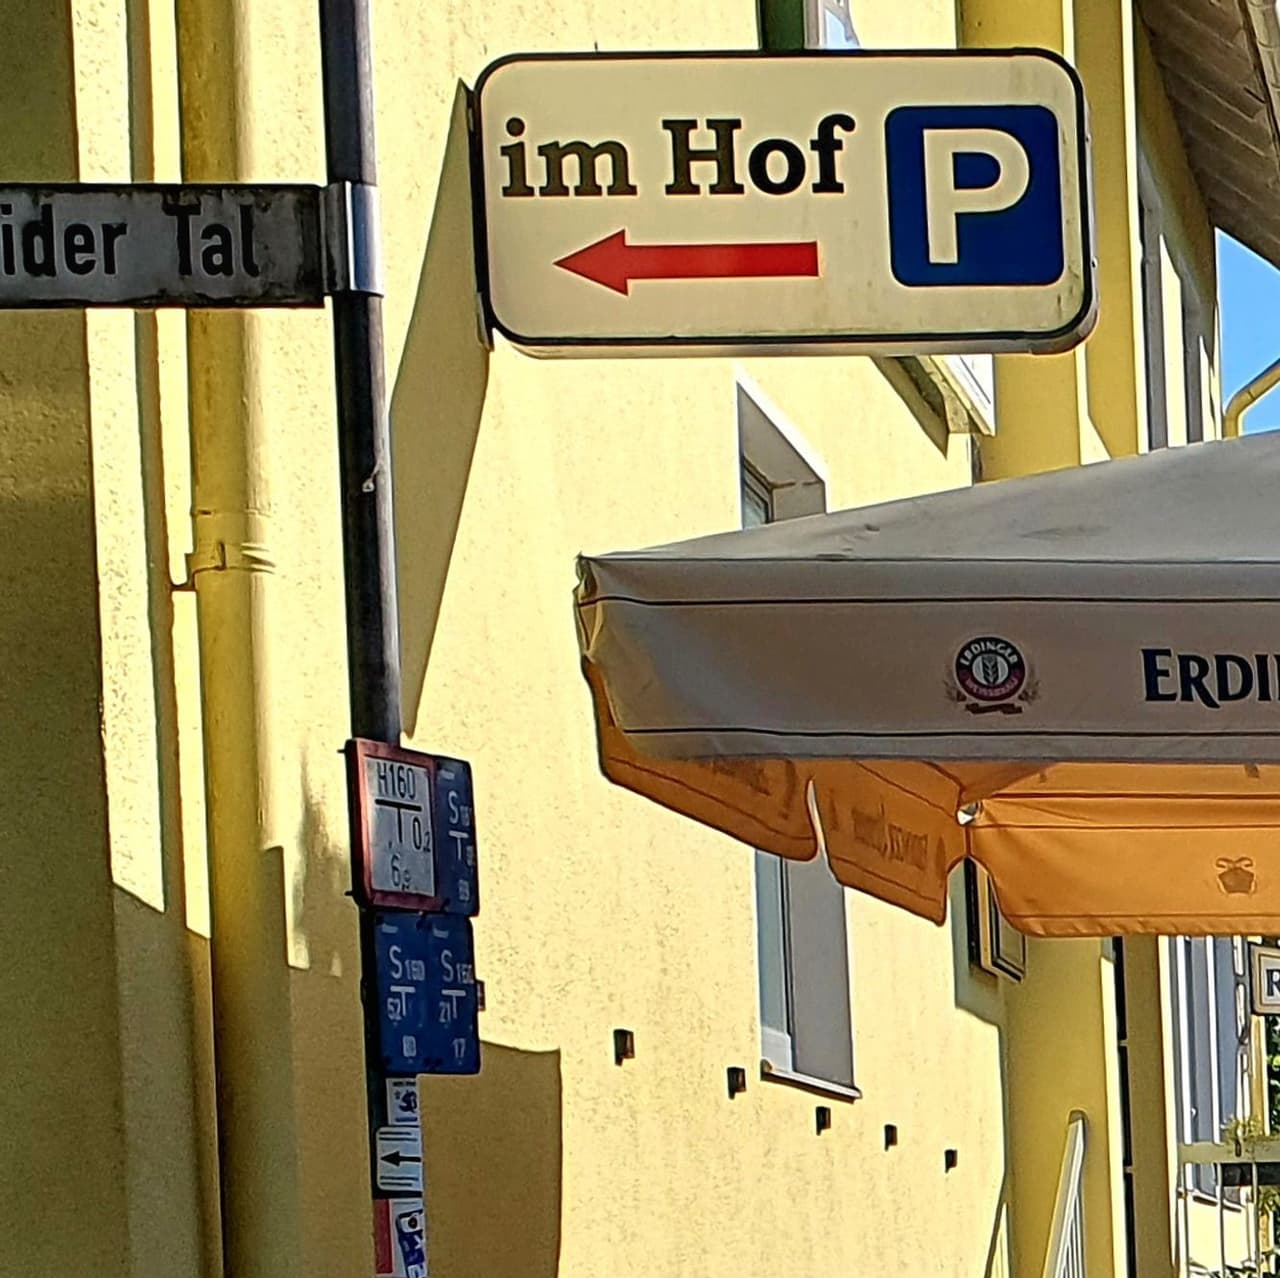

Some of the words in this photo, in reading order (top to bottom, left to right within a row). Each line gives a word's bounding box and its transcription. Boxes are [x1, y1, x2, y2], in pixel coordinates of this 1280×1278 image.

[500, 117, 638, 197] im
[662, 114, 856, 196] Hof
[923, 128, 1030, 264] P
[162, 199, 260, 277] Tal
[376, 762, 416, 799] H160
